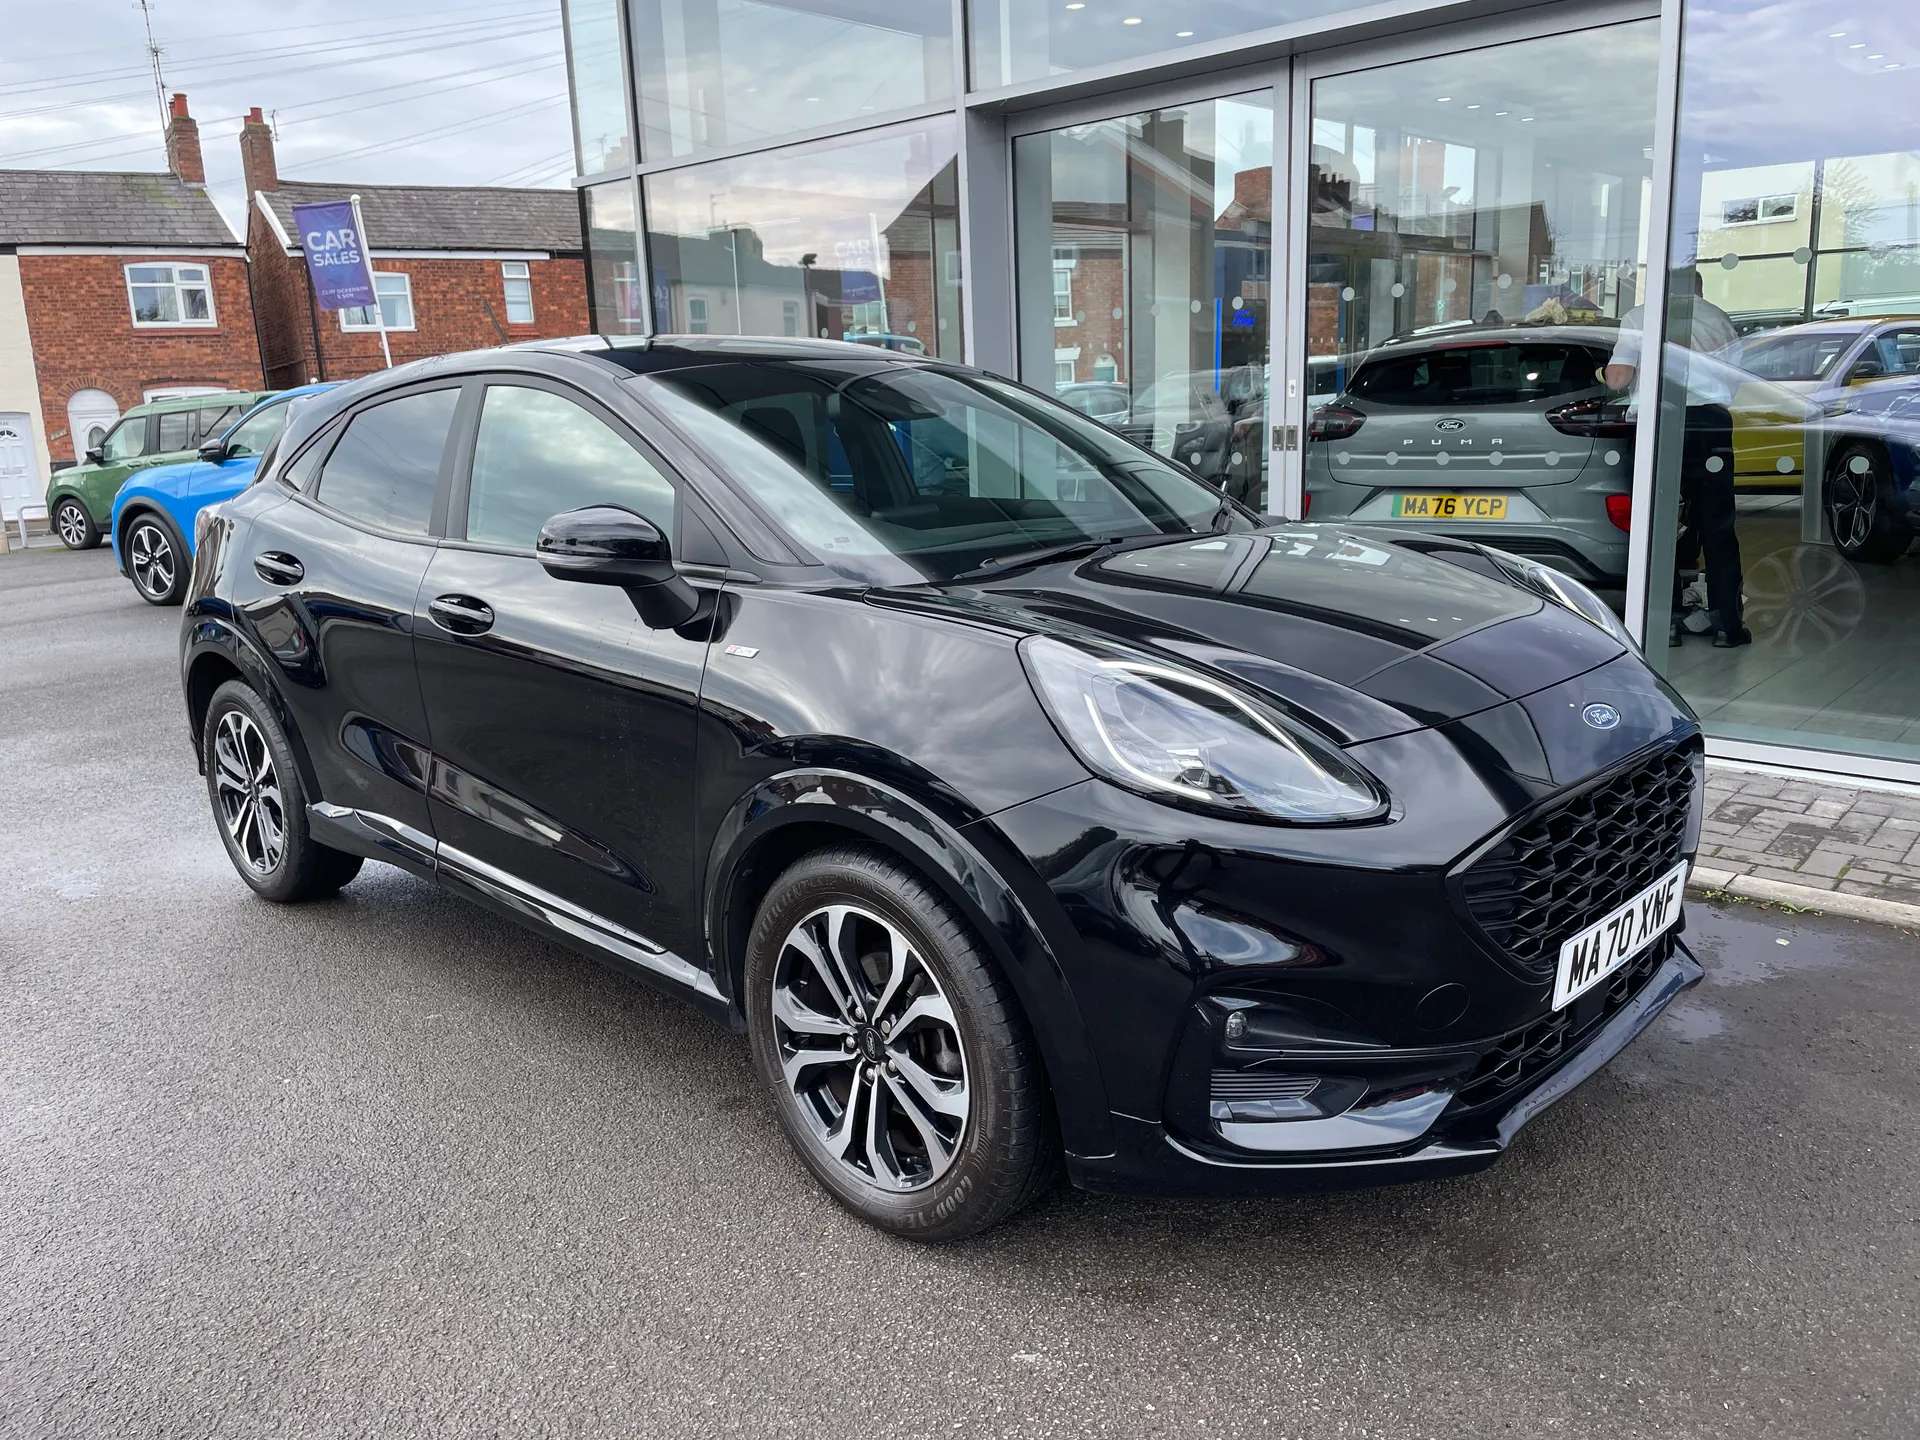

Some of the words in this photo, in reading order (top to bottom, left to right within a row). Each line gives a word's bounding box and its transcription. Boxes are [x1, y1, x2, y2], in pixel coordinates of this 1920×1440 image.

[306, 229, 356, 250] CAR
[313, 250, 360, 266] SALES
[1404, 497, 1456, 516] MA76
[1463, 498, 1503, 516] YCP
[1567, 908, 1635, 994] MA70
[1636, 874, 1679, 945] XNF
